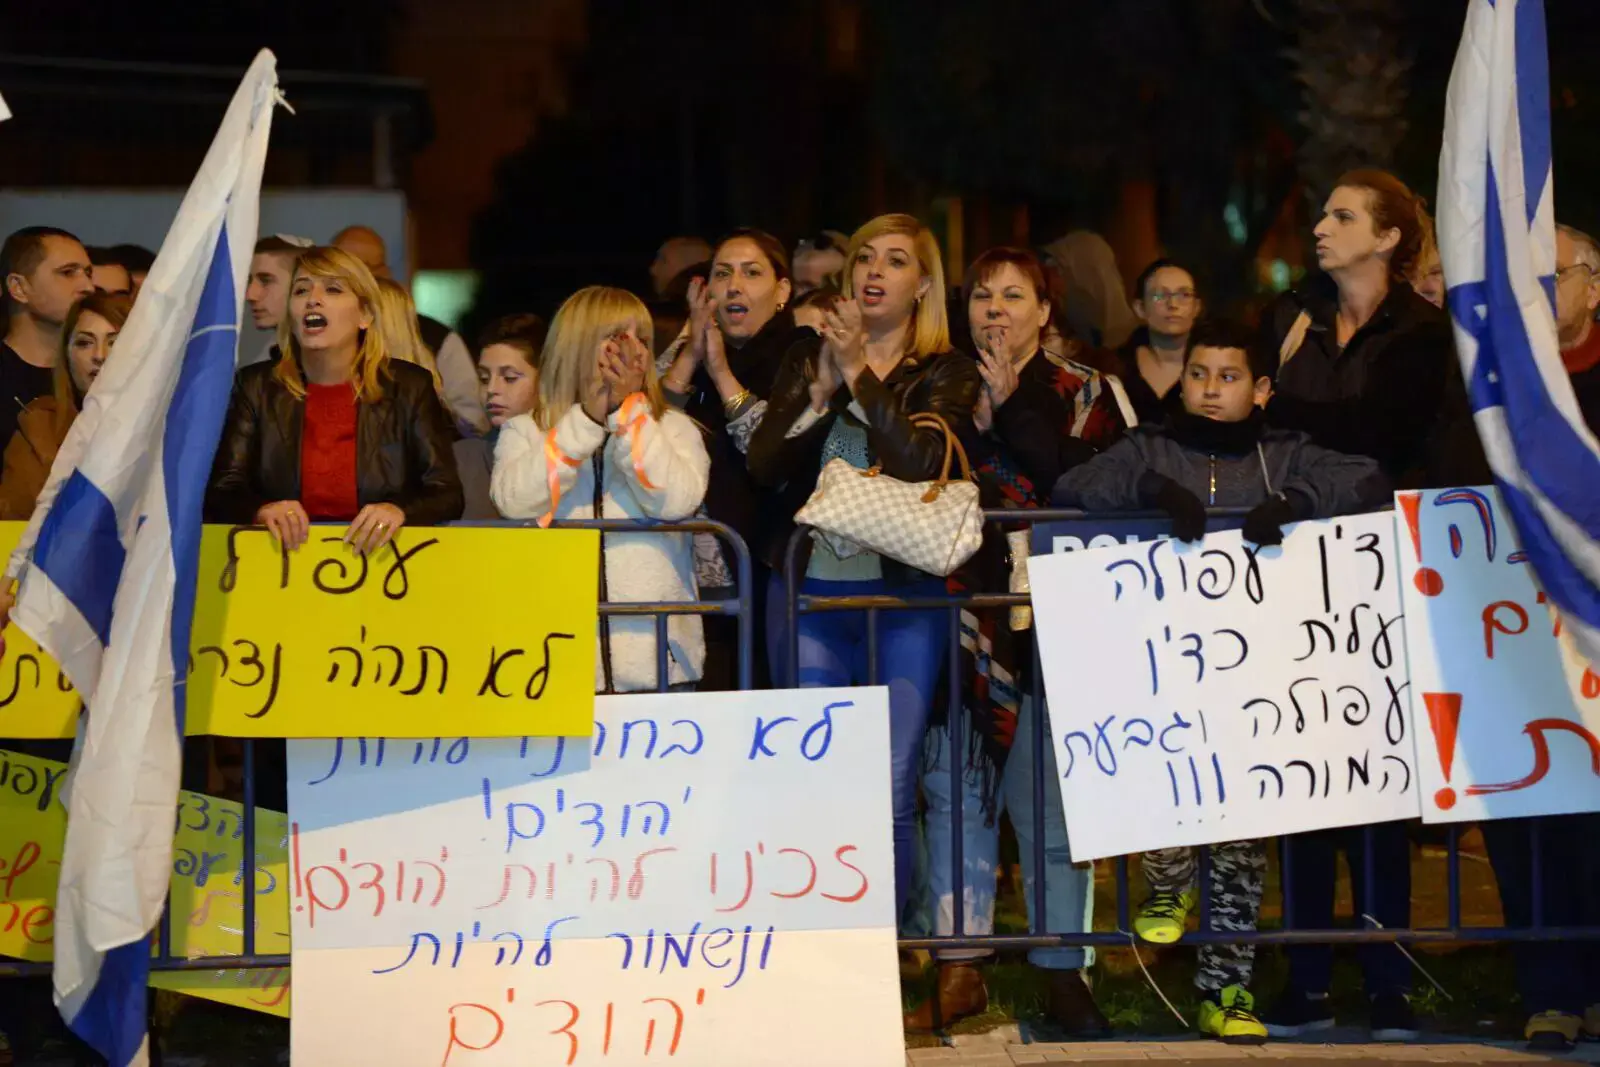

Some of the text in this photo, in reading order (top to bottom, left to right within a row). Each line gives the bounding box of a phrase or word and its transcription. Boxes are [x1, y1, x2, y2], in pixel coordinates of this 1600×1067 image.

[218, 526, 440, 600] עפול
[1105, 525, 1386, 613] דין עפולה
[327, 625, 449, 696] תהיה
[1145, 604, 1405, 696] עלית כדין
[1481, 591, 1562, 660] ים
[476, 632, 576, 700] לא
[748, 701, 854, 761] לא
[1063, 676, 1411, 779] עפולה וגבעת
[480, 778, 692, 852] יהודים!
[292, 822, 449, 928] יהודים!
[476, 847, 679, 910] להיות
[710, 842, 869, 912] זכינו
[372, 916, 774, 988] ונשמור להיות
[441, 987, 706, 1067] יהודים
